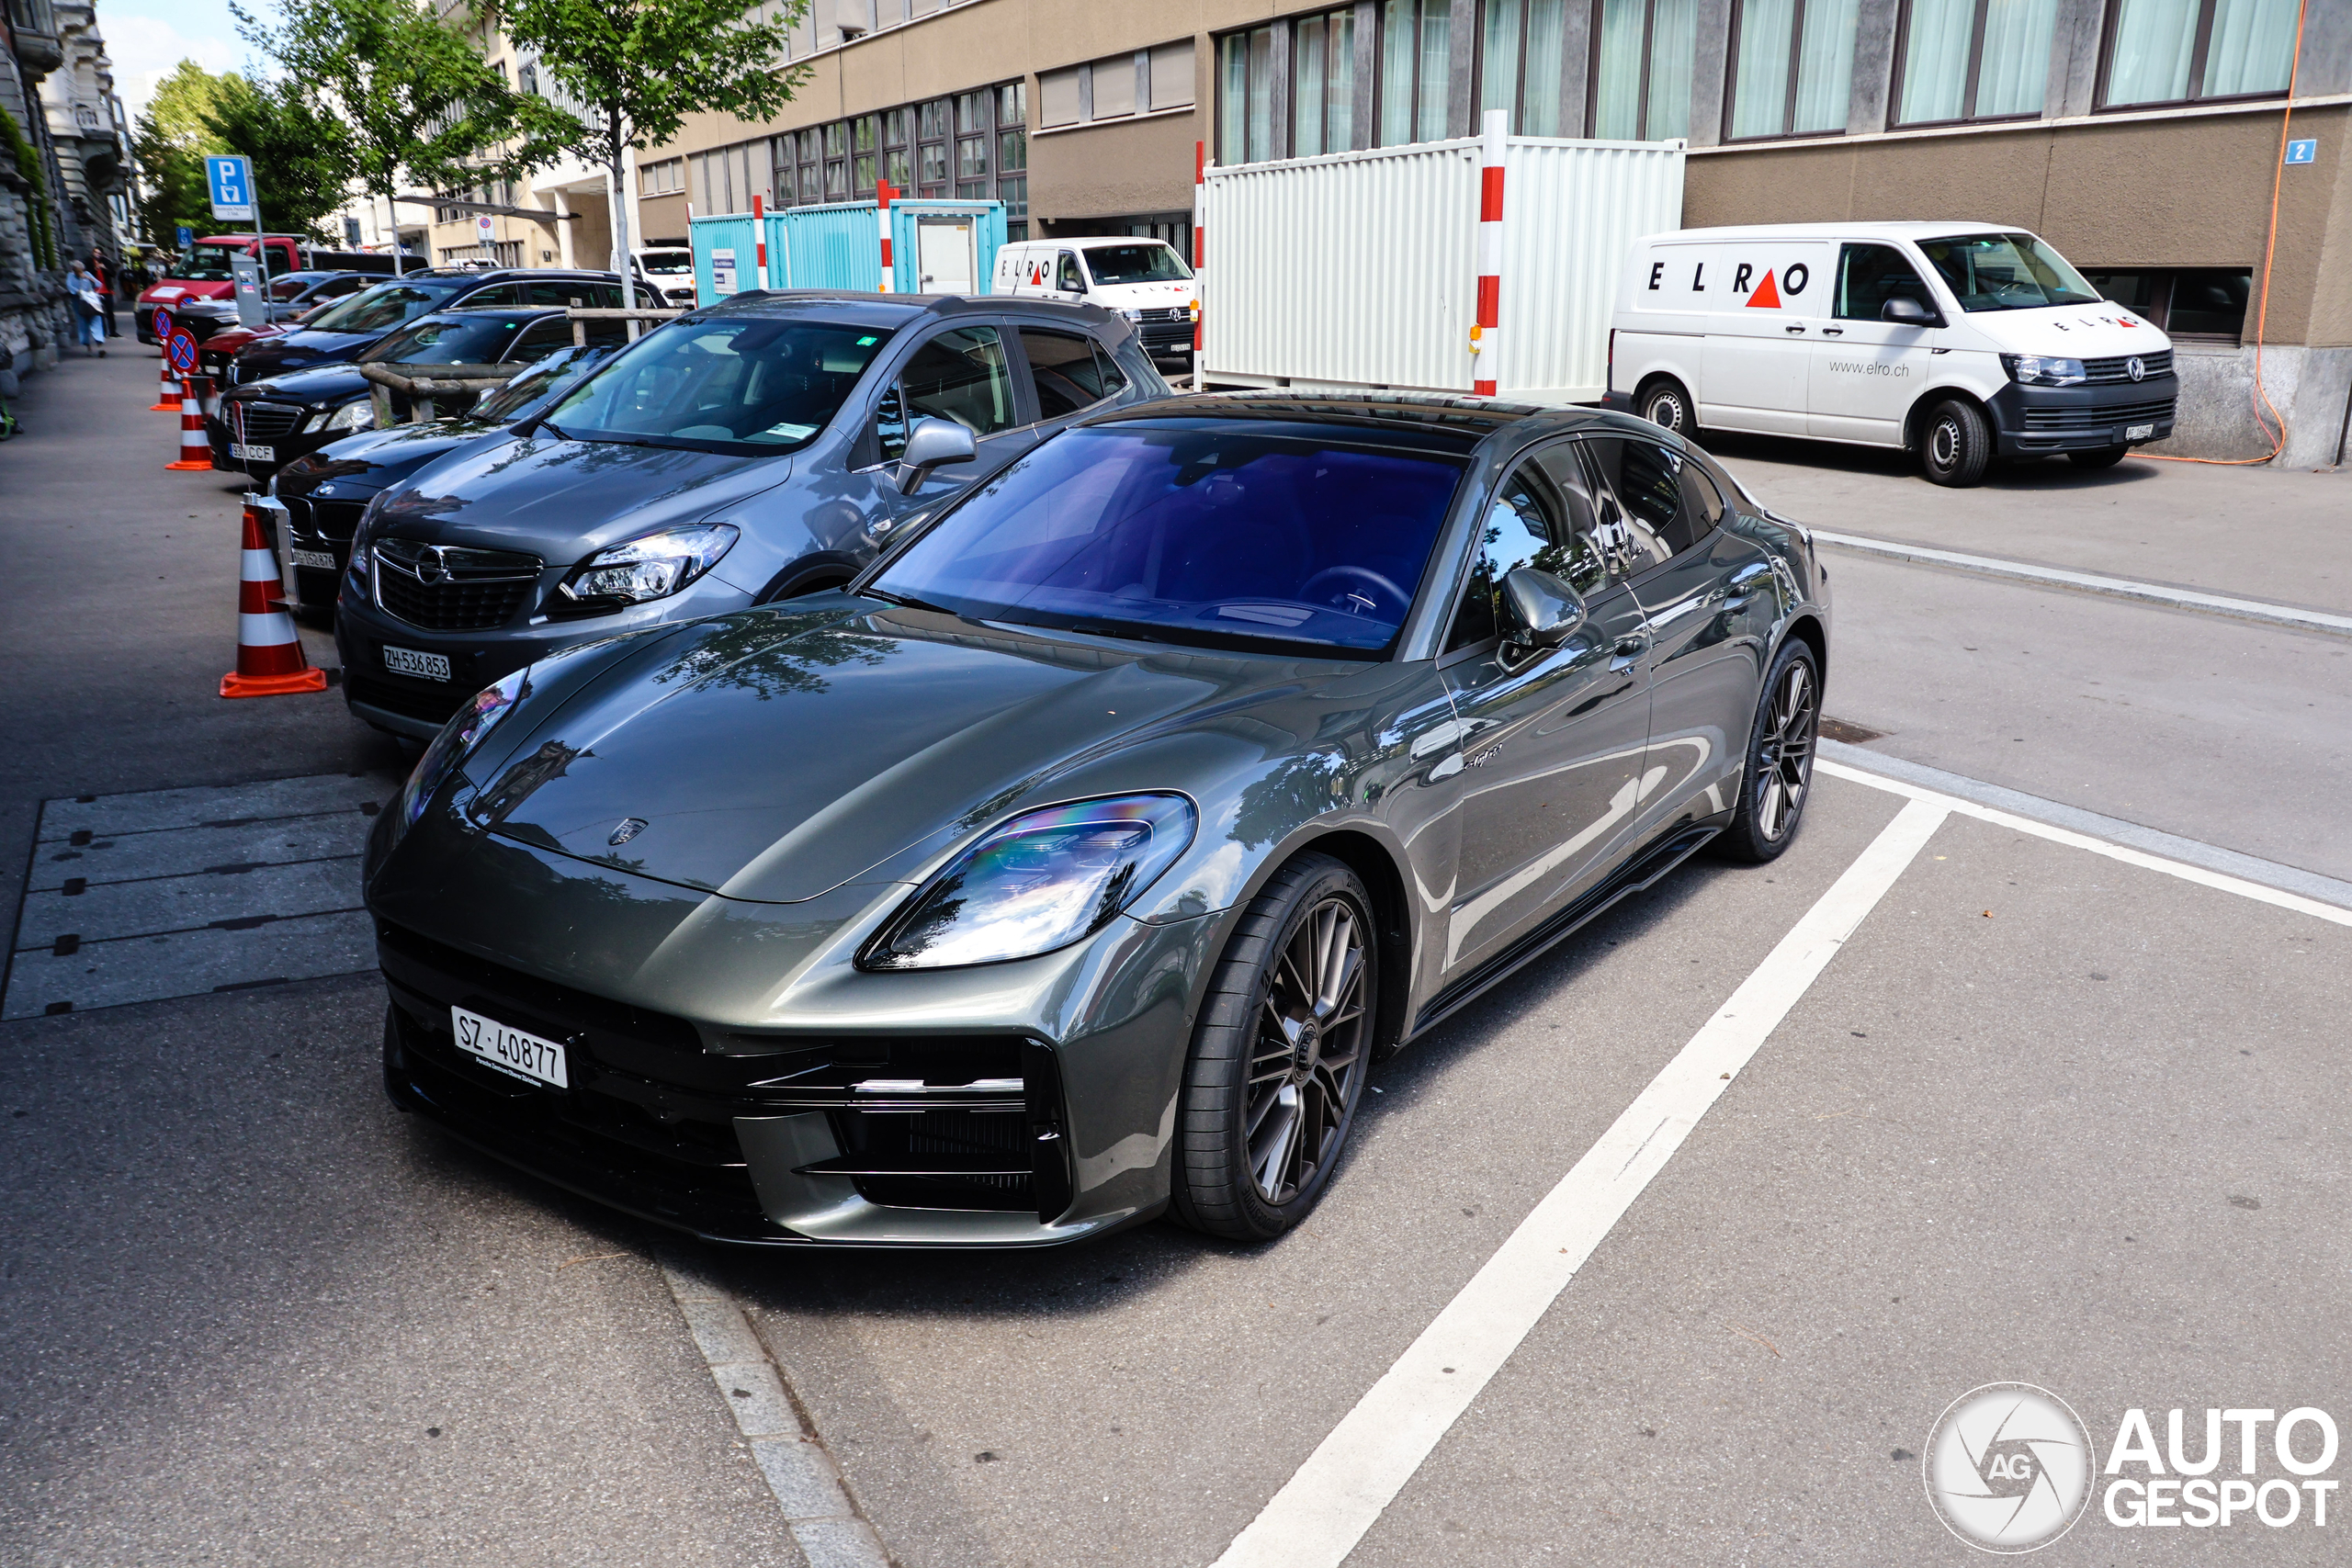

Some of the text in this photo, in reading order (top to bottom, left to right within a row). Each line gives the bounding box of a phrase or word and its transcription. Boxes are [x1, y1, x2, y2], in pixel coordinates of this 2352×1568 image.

[2295, 143, 2306, 160] 2
[218, 161, 236, 185] P
[1001, 260, 1050, 278] ELRO
[1648, 262, 1810, 296] ELRO
[1132, 286, 1190, 294] ELRO
[2052, 316, 2139, 332] ELRO
[1829, 361, 1910, 378] www.elro.ch
[249, 446, 271, 459] CCF
